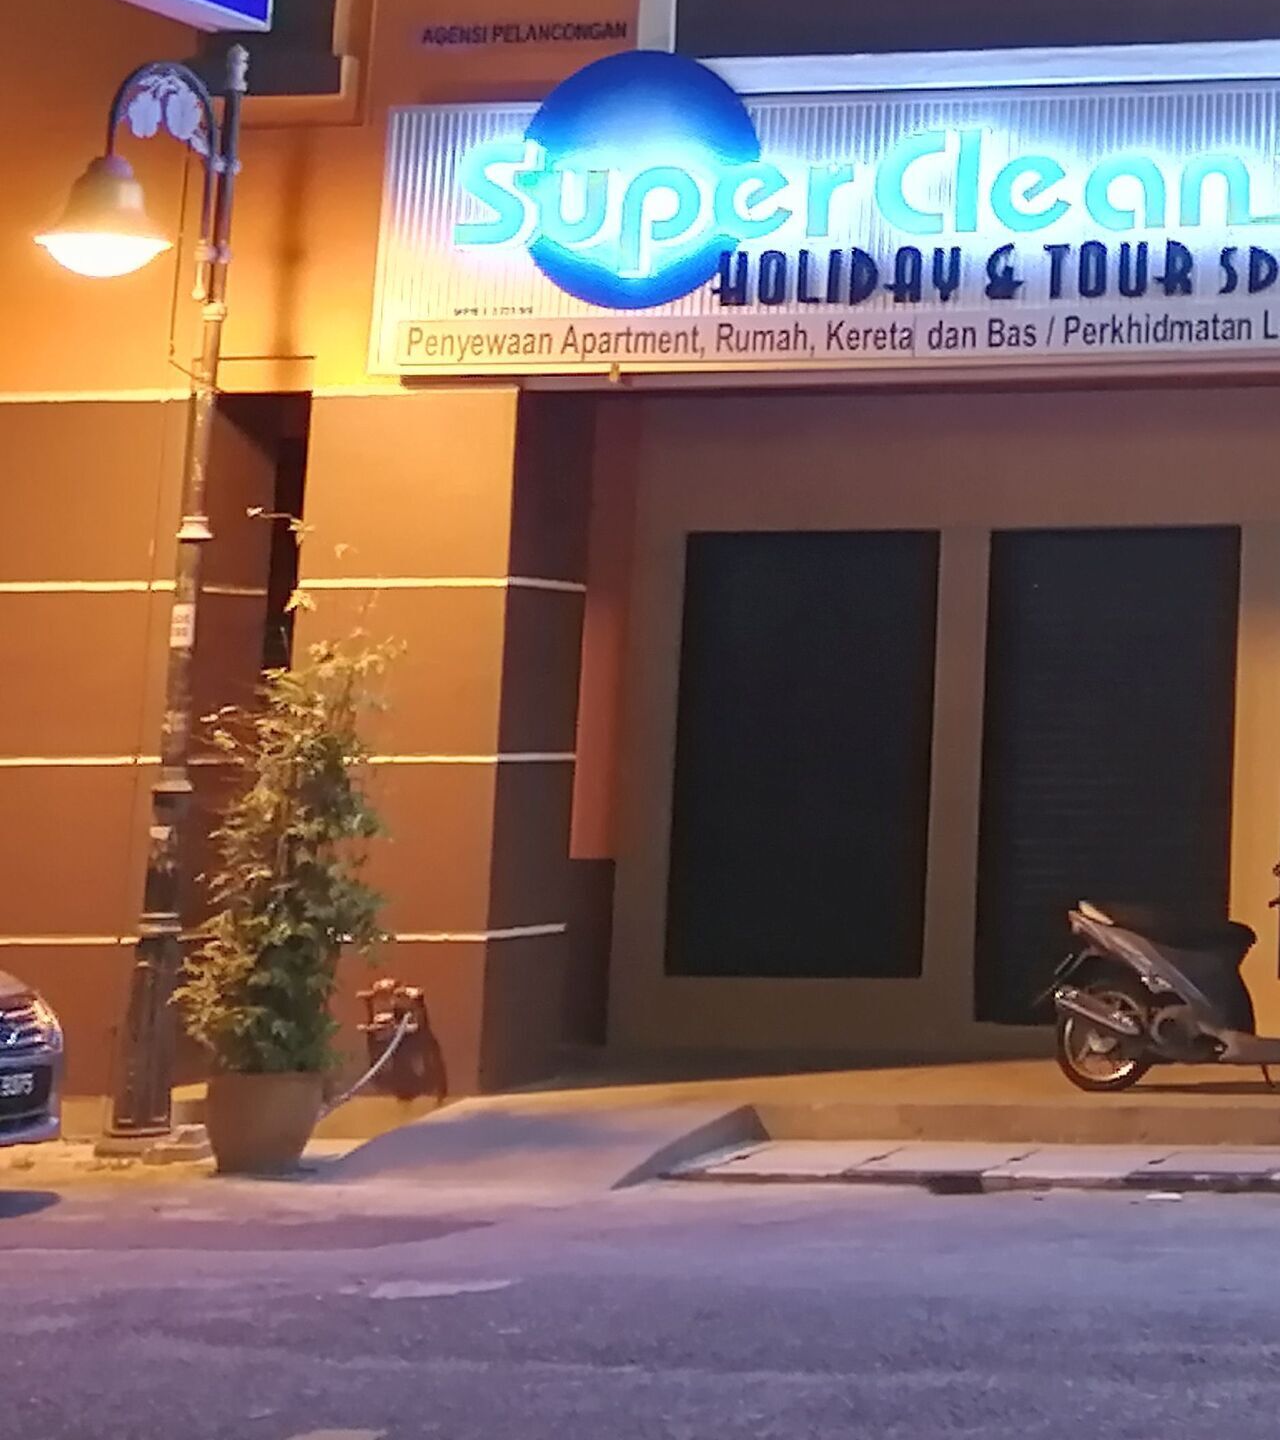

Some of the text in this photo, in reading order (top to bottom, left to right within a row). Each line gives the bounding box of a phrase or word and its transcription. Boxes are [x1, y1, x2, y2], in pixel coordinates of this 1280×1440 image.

[491, 21, 628, 44] PELANCONGAN
[455, 126, 1252, 277] SuperClean
[712, 245, 963, 307] HOLIDAY
[980, 244, 1032, 302] &
[1044, 240, 1194, 300] TOUR
[405, 323, 553, 362] Penyewaan
[561, 319, 705, 360] Apartment,
[716, 320, 816, 357] Rumah,
[826, 321, 913, 352] Kereta
[927, 319, 977, 350] dan
[987, 318, 1038, 349] Bas
[1063, 309, 1254, 347] Perkhidmatan
